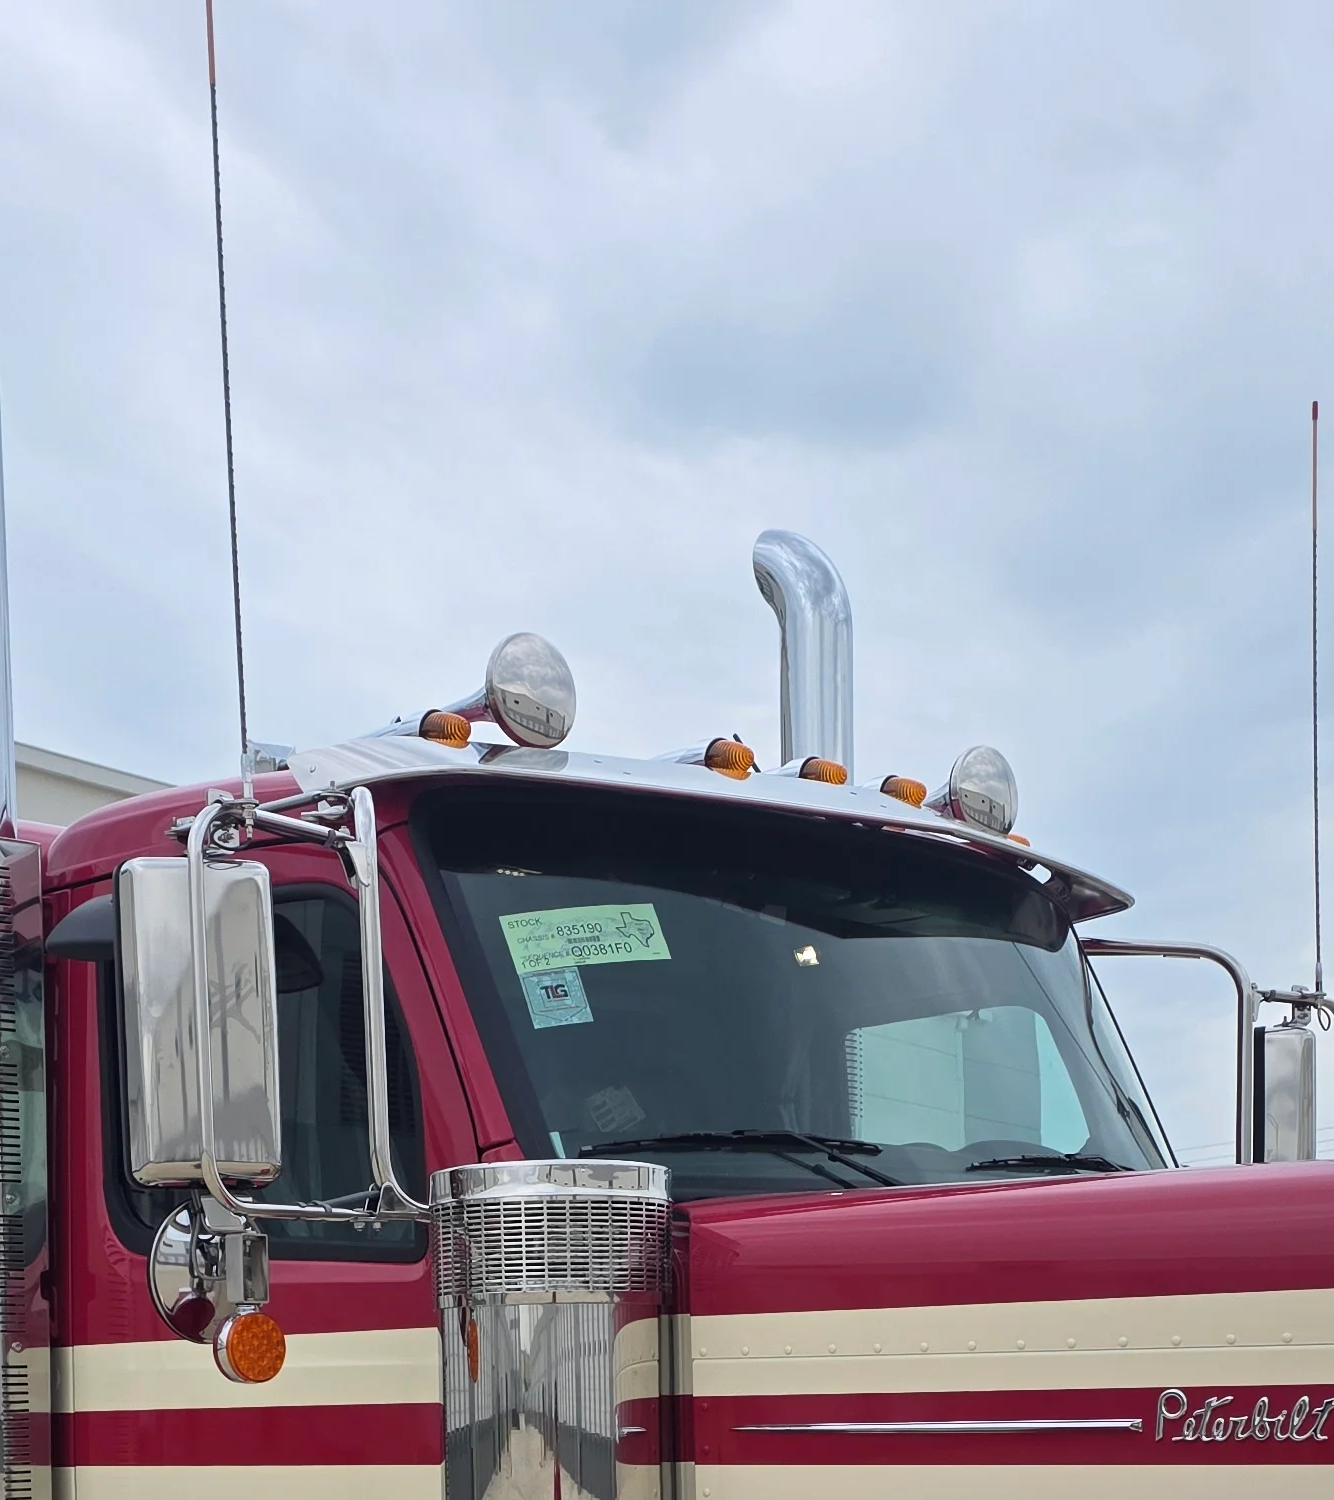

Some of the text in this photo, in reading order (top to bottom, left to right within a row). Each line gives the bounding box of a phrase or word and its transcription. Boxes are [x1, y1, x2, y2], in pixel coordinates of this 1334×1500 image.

[508, 917, 542, 929] STOCK
[517, 934, 549, 944] CHASSIS
[556, 922, 602, 937] 835190
[571, 942, 632, 957] Q0381F0
[540, 984, 568, 999] TLG
